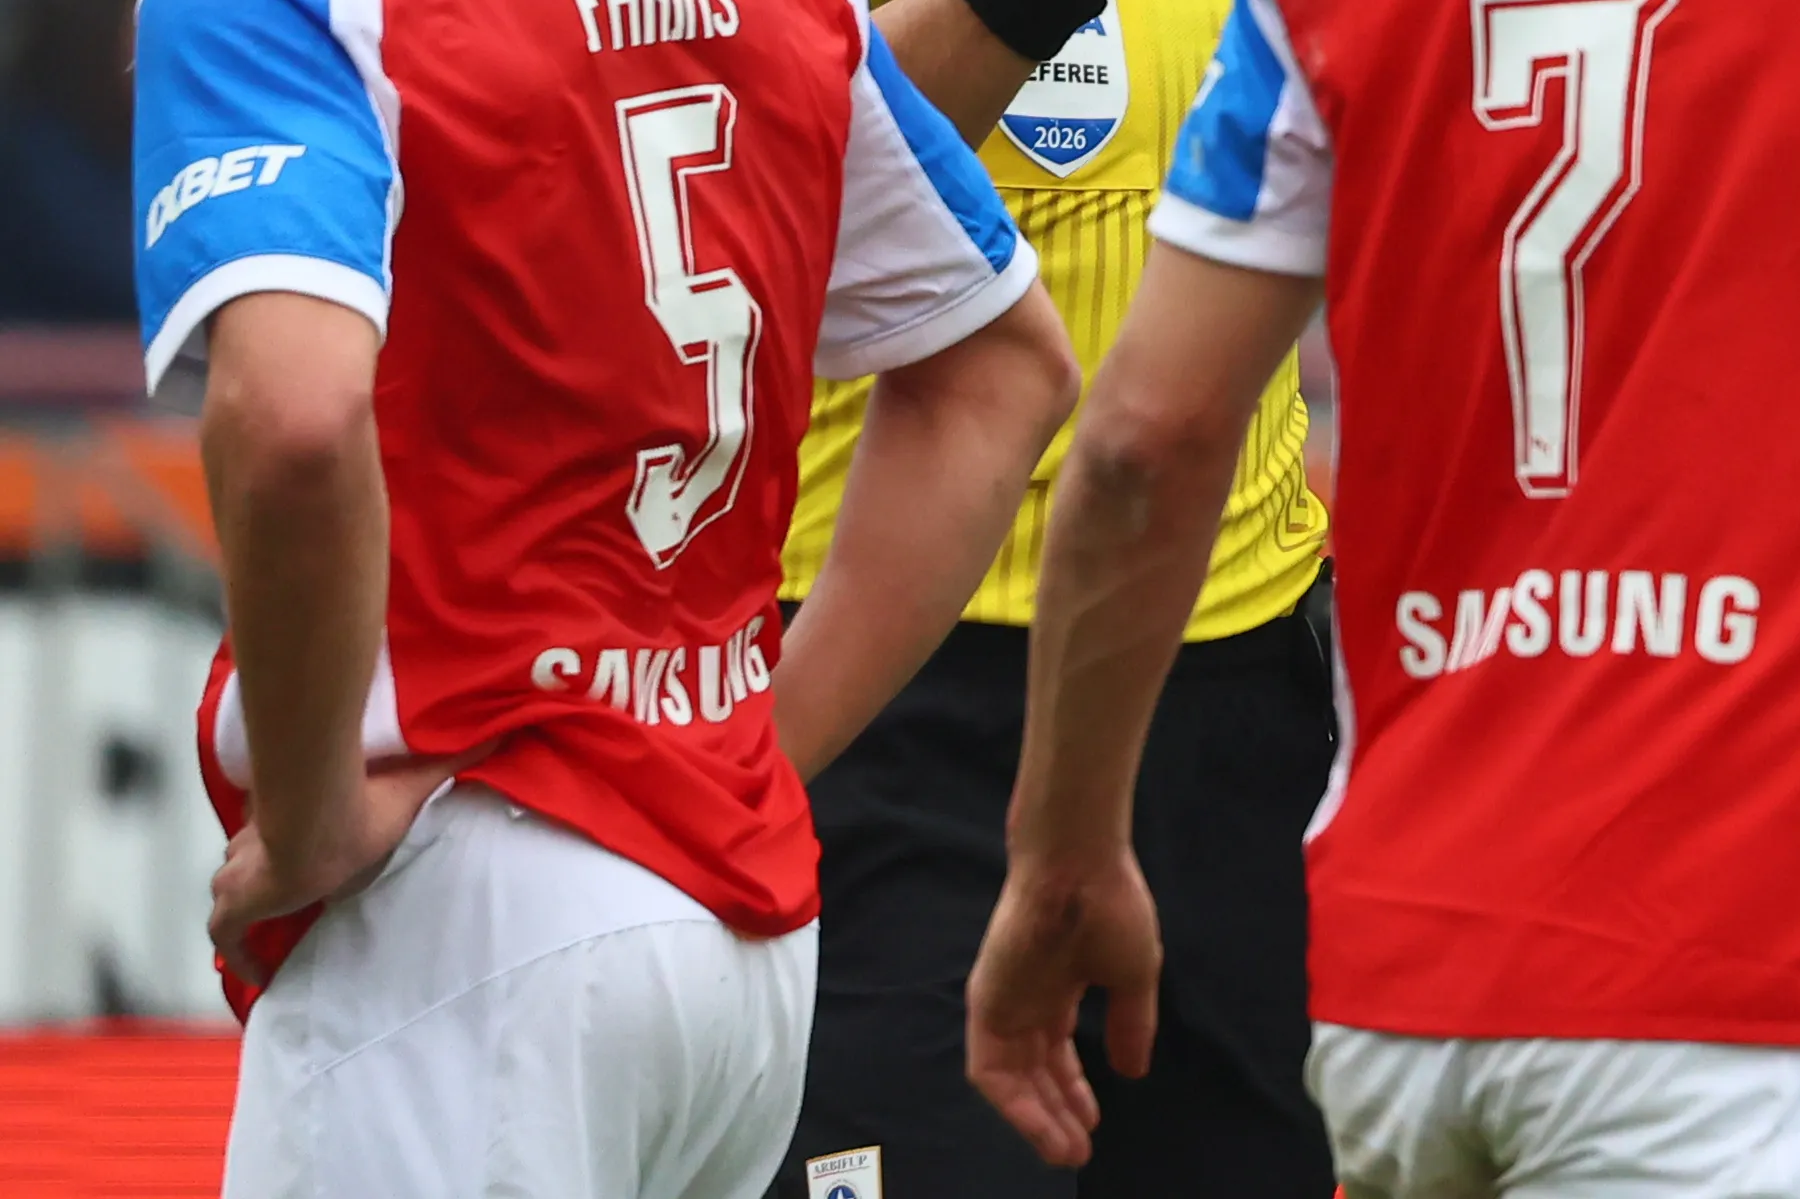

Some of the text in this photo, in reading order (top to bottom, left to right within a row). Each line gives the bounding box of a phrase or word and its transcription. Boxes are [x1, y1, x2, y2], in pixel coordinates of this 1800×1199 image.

[1026, 62, 1109, 85] FEREE
[1034, 126, 1087, 150] 2026
[145, 144, 308, 250] 1XBET
[615, 84, 762, 571] 5
[530, 615, 772, 727] SAMSUNG
